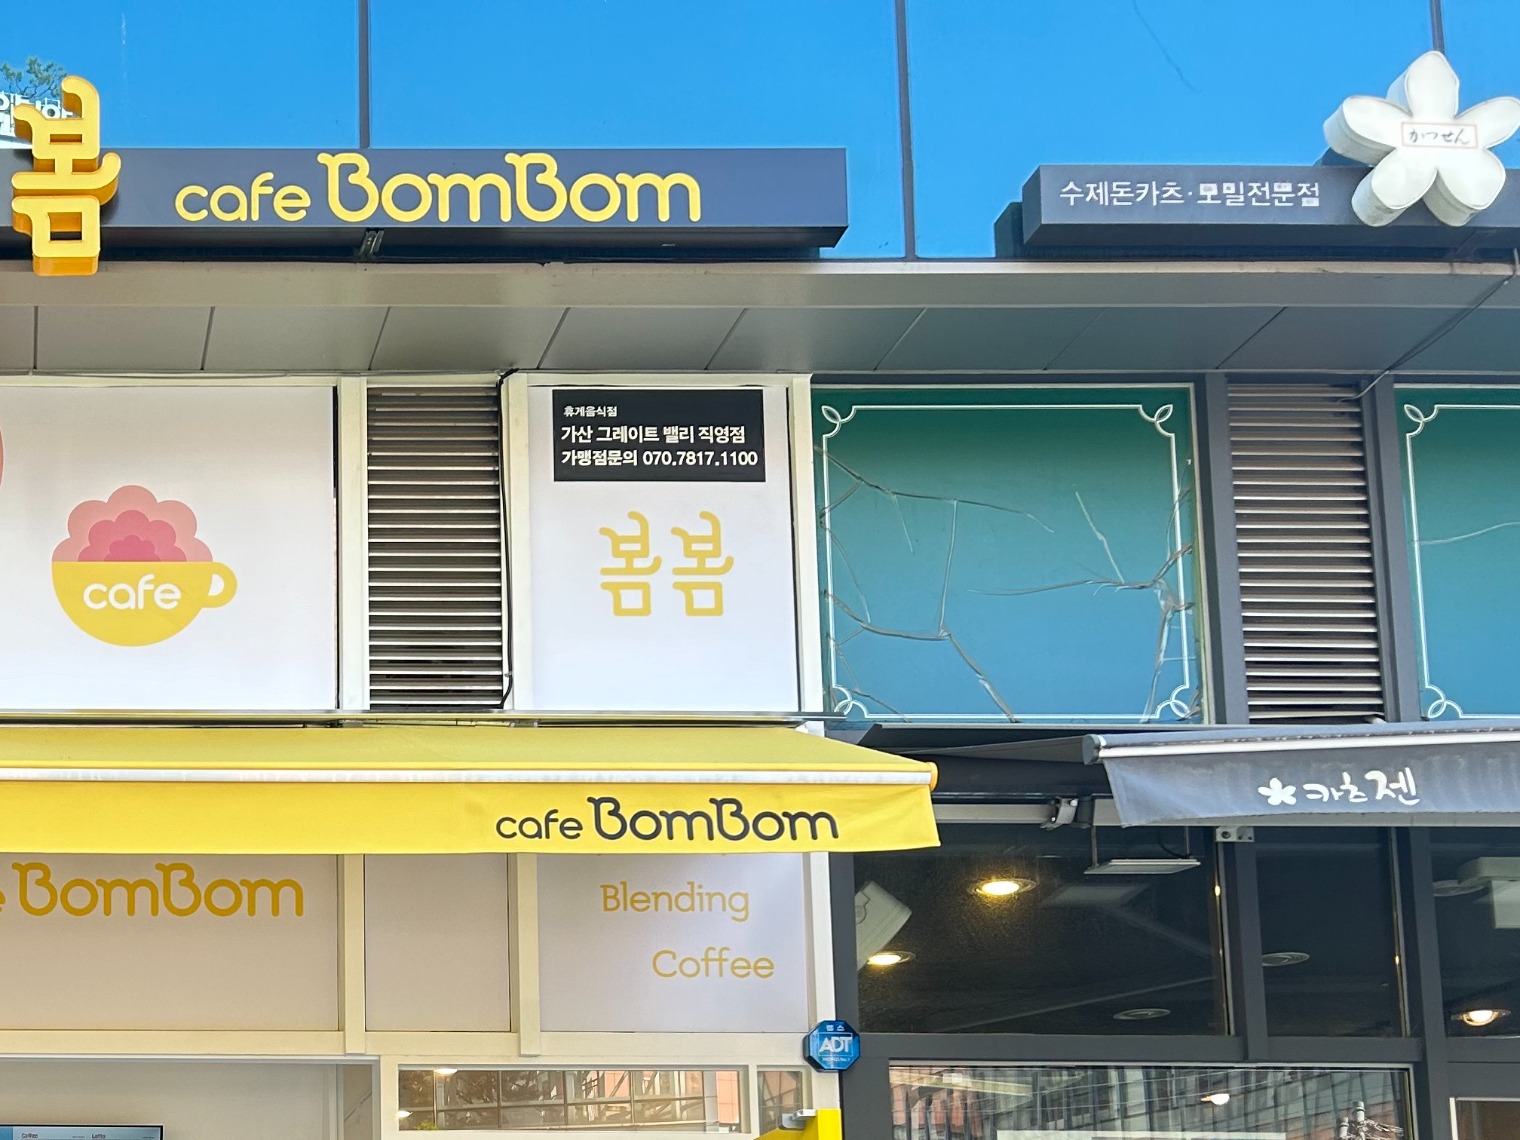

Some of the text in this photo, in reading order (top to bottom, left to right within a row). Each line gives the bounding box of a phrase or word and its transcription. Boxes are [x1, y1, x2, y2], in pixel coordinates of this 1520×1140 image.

[175, 152, 701, 223] cafe BomBom
[563, 405, 618, 417] 휴게음식점
[561, 425, 745, 443] 가산 그레이트 밸리 직영점
[561, 450, 758, 467] 가맹점문의 070.7817.1100
[598, 510, 734, 618] 봄봄
[83, 573, 182, 611] cafe
[496, 796, 839, 841] cafe BomBom
[11, 862, 304, 918] BomBom
[600, 881, 749, 922] Blending
[652, 946, 774, 979] Coffee
[819, 1036, 853, 1053] ADT
